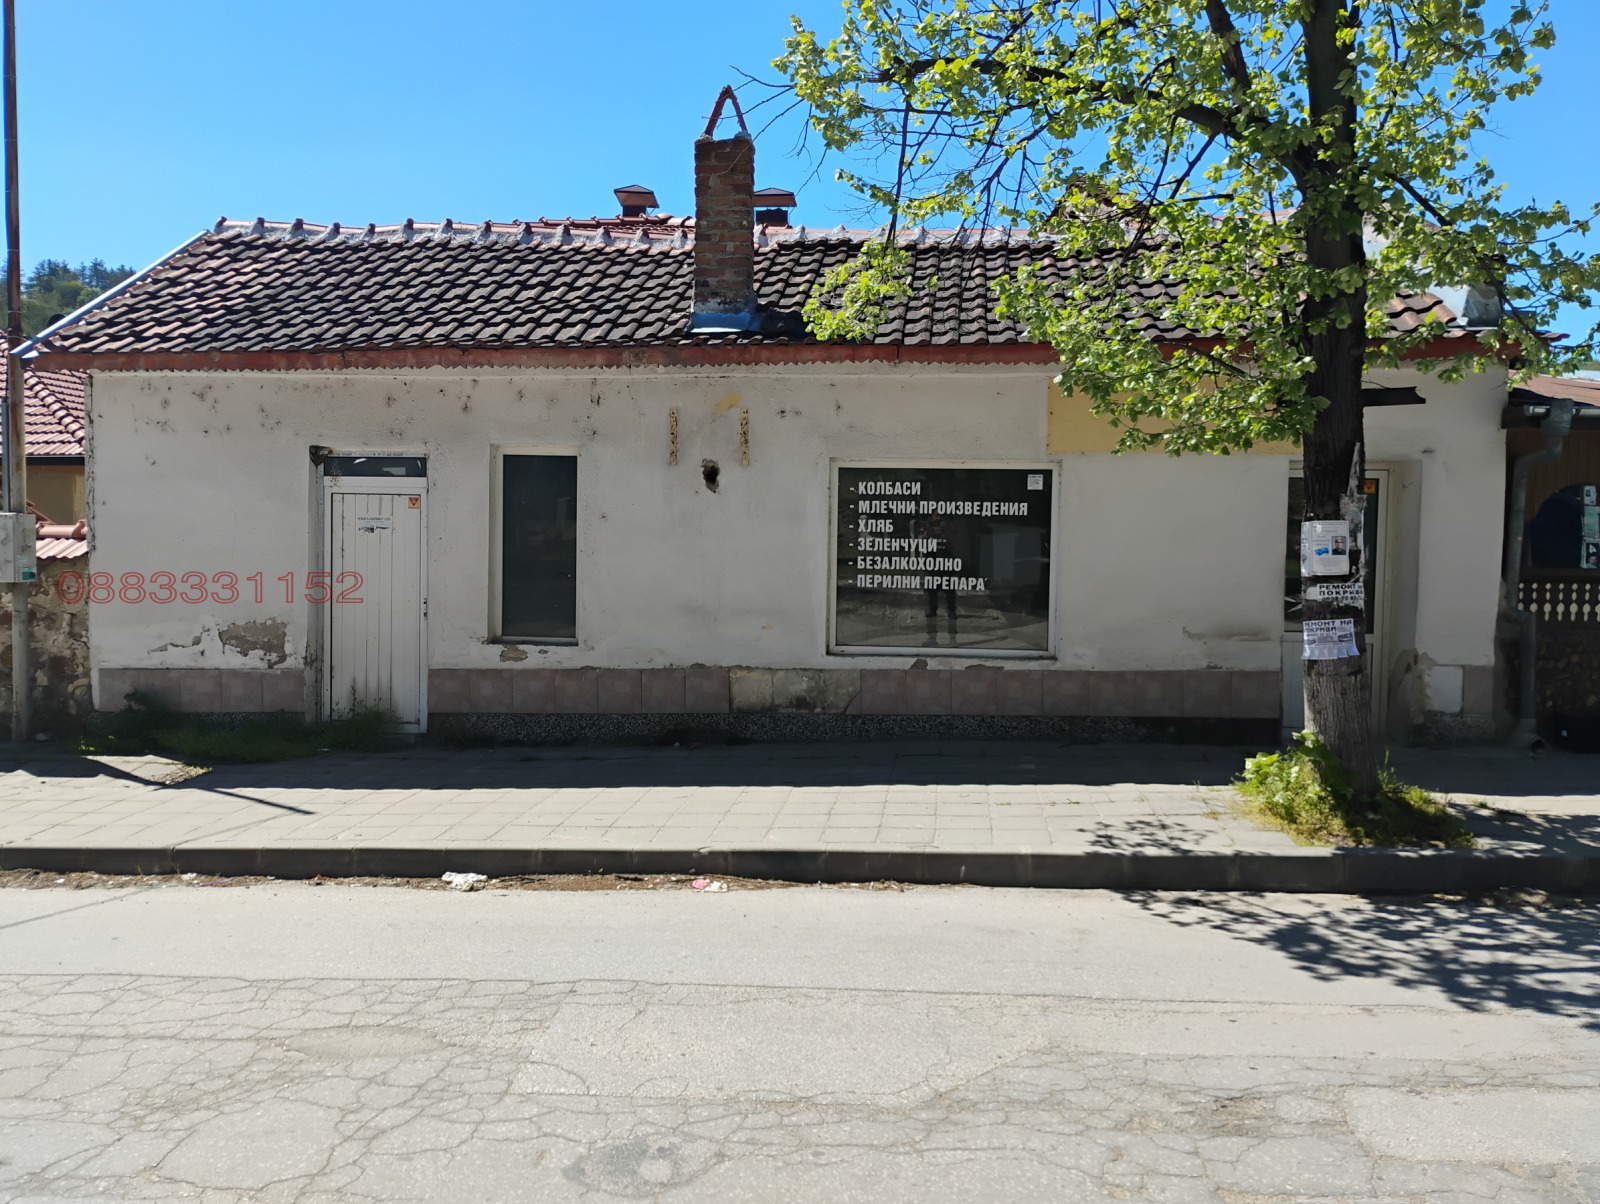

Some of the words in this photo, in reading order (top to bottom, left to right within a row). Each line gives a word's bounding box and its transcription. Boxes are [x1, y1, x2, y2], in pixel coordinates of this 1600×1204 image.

[858, 481, 921, 495] КОЛБАСИ
[858, 500, 916, 514] МЛЕЧНИ
[919, 501, 1028, 517] ПРОИЗВЕДЕНИЯ
[857, 519, 894, 533] ХЛЯБ
[857, 537, 937, 554] ЗЕЛЕНЧУЦИ
[857, 556, 962, 572] БЕЗАЛКОХОЛНО
[857, 574, 920, 589] ПЕРИЛНИ
[924, 576, 989, 591] ПРЕПАРА
